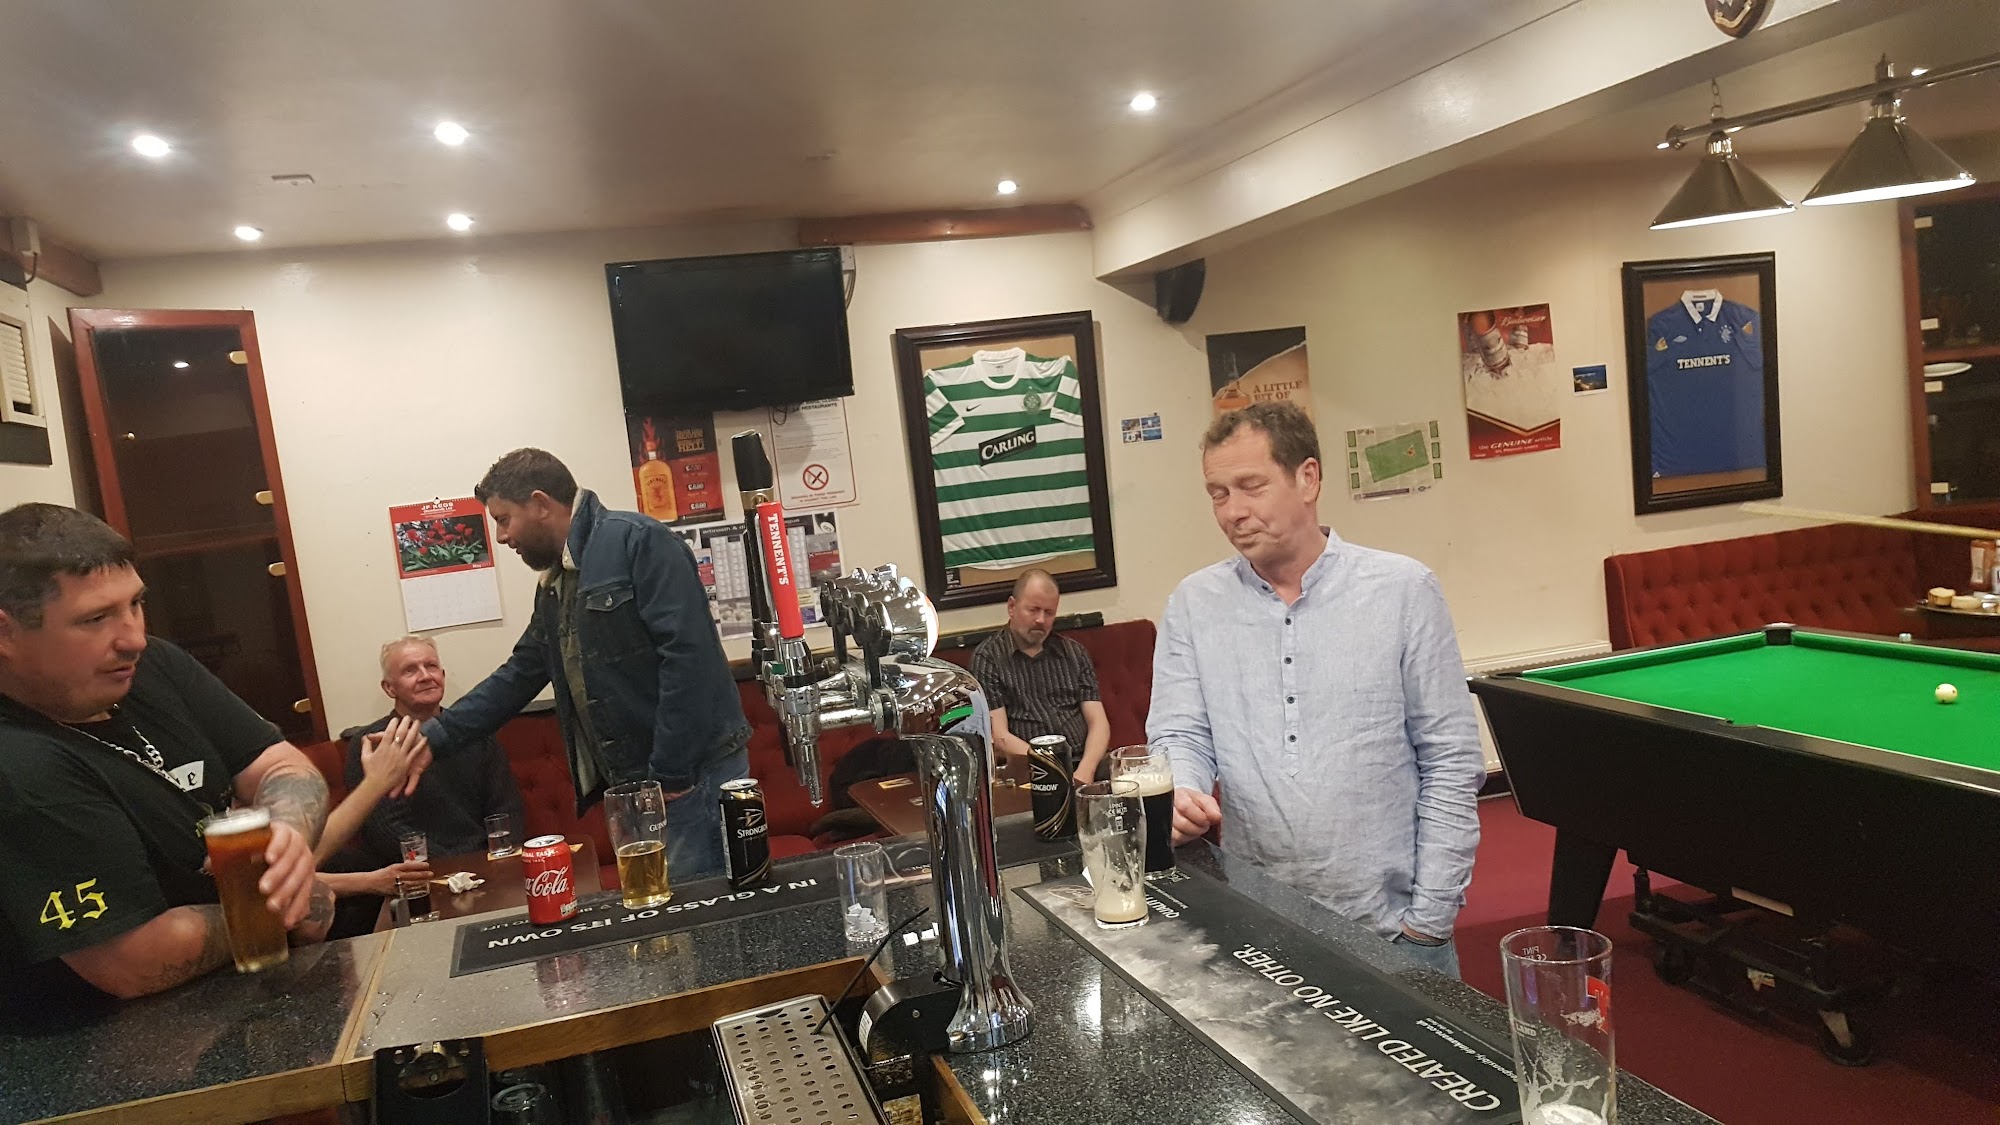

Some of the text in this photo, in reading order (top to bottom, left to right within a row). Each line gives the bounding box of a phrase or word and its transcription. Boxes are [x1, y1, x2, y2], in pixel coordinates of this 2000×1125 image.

[1677, 354, 1731, 369] TENNENT'S
[1253, 381, 1302, 393] A LITTLE
[1276, 391, 1291, 399] OF
[981, 431, 1035, 460] CARLING
[1490, 438, 1534, 449] GENUINE
[767, 513, 790, 586] TENNENT'S
[40, 877, 109, 930] 45
[487, 878, 818, 948] IN A GLASS OF ITS OWN
[1232, 943, 1501, 1111] CREATED LIKE NO OTHER.
